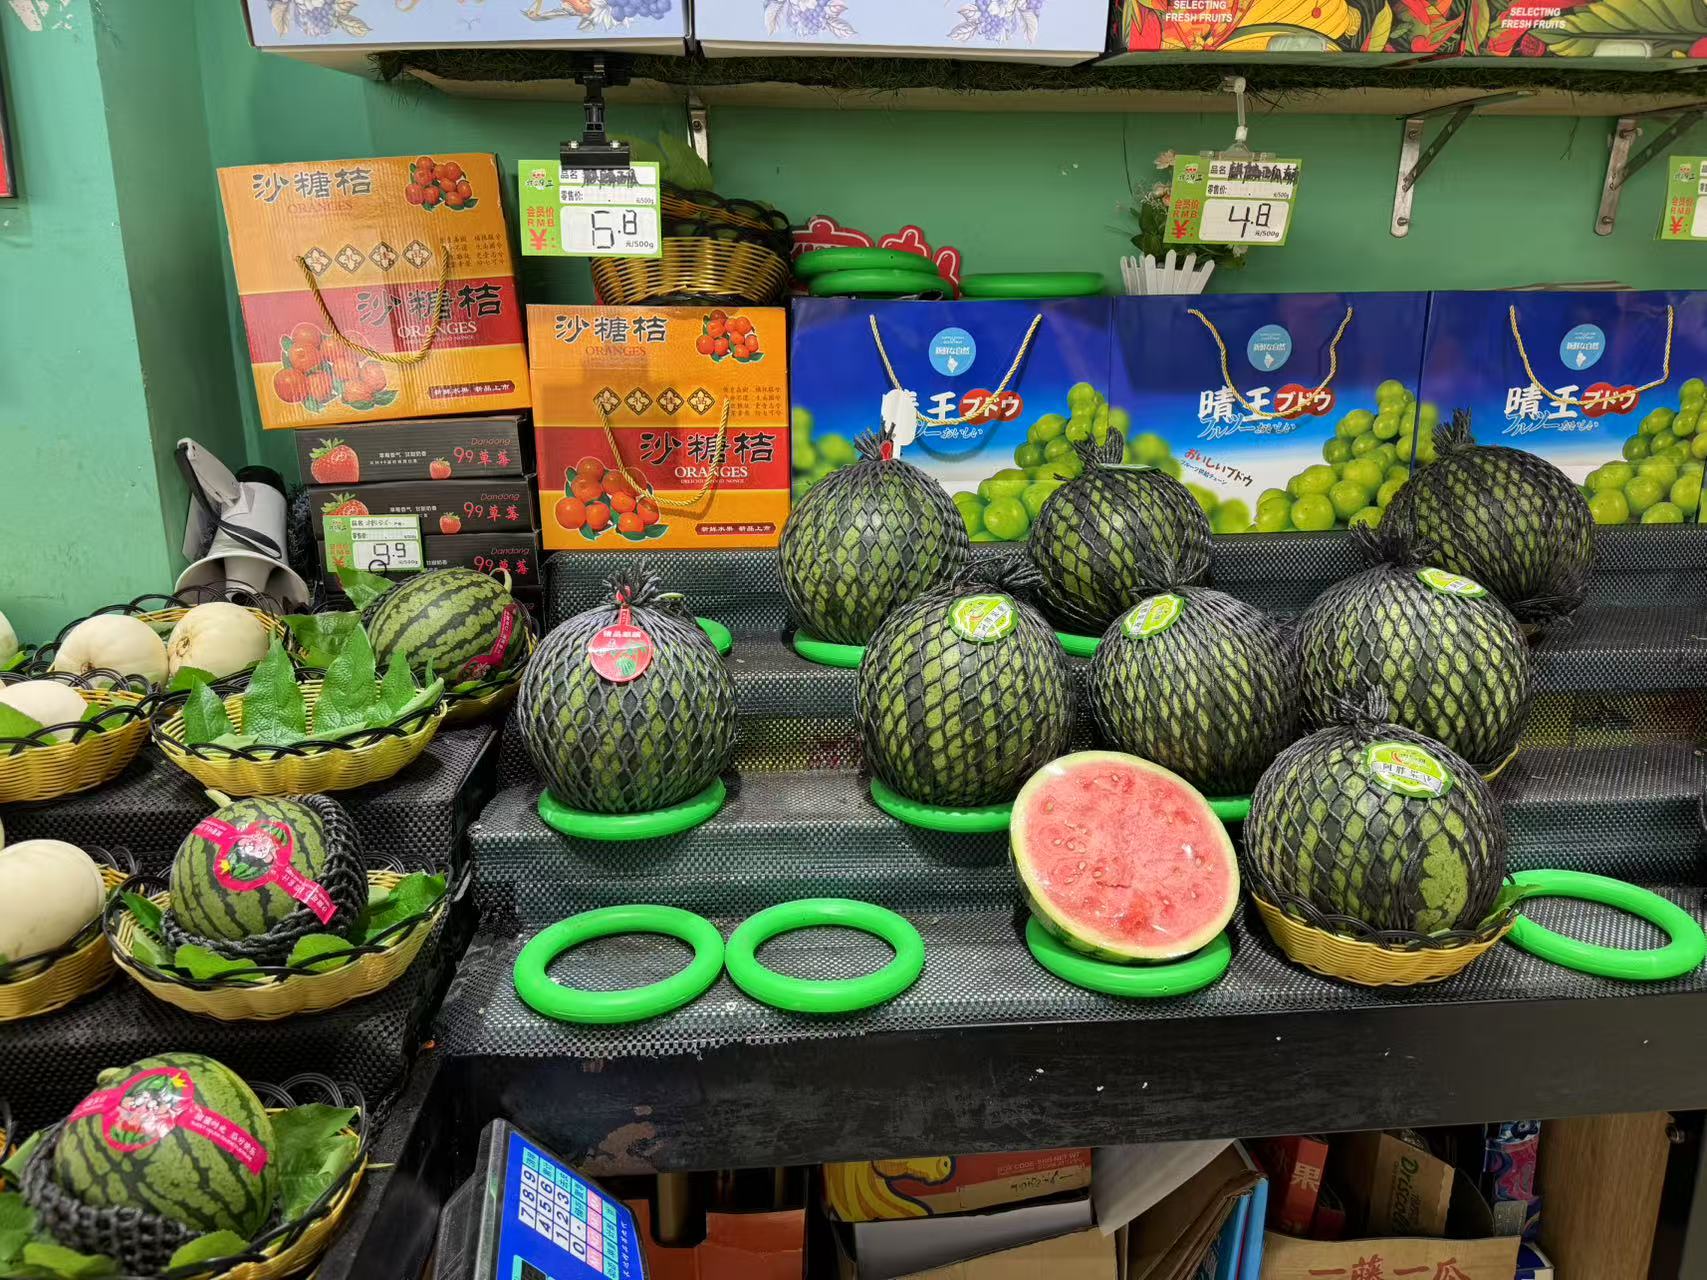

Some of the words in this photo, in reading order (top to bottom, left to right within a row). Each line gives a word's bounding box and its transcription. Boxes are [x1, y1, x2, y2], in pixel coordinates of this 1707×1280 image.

[1173, 0, 1227, 10] SELECTING
[1165, 13, 1197, 22] FRESH
[1199, 13, 1233, 23] FRUITS
[1510, 7, 1561, 17] SELECTING
[1501, 19, 1532, 29] FRESH
[1533, 19, 1566, 29] FRUITS
[251, 167, 372, 203] 沙糖桔
[1228, 203, 1272, 238] 4.8
[356, 283, 502, 328] 沙糖桔
[555, 314, 669, 344] 沙糖桔
[639, 431, 776, 465] 沙糖桔
[1184, 448, 1254, 487] おいしいブドウ
[524, 1170, 535, 1182] 9
[1289, 1161, 1321, 1192] 果
[541, 1182, 552, 1194] 6
[522, 1189, 535, 1201] 8
[557, 1192, 569, 1205] 3
[540, 1201, 552, 1213] 5
[521, 1208, 535, 1221] 7
[557, 1212, 568, 1225] 2
[539, 1218, 551, 1232] 4
[556, 1231, 567, 1241] 1
[573, 1241, 584, 1255] 0
